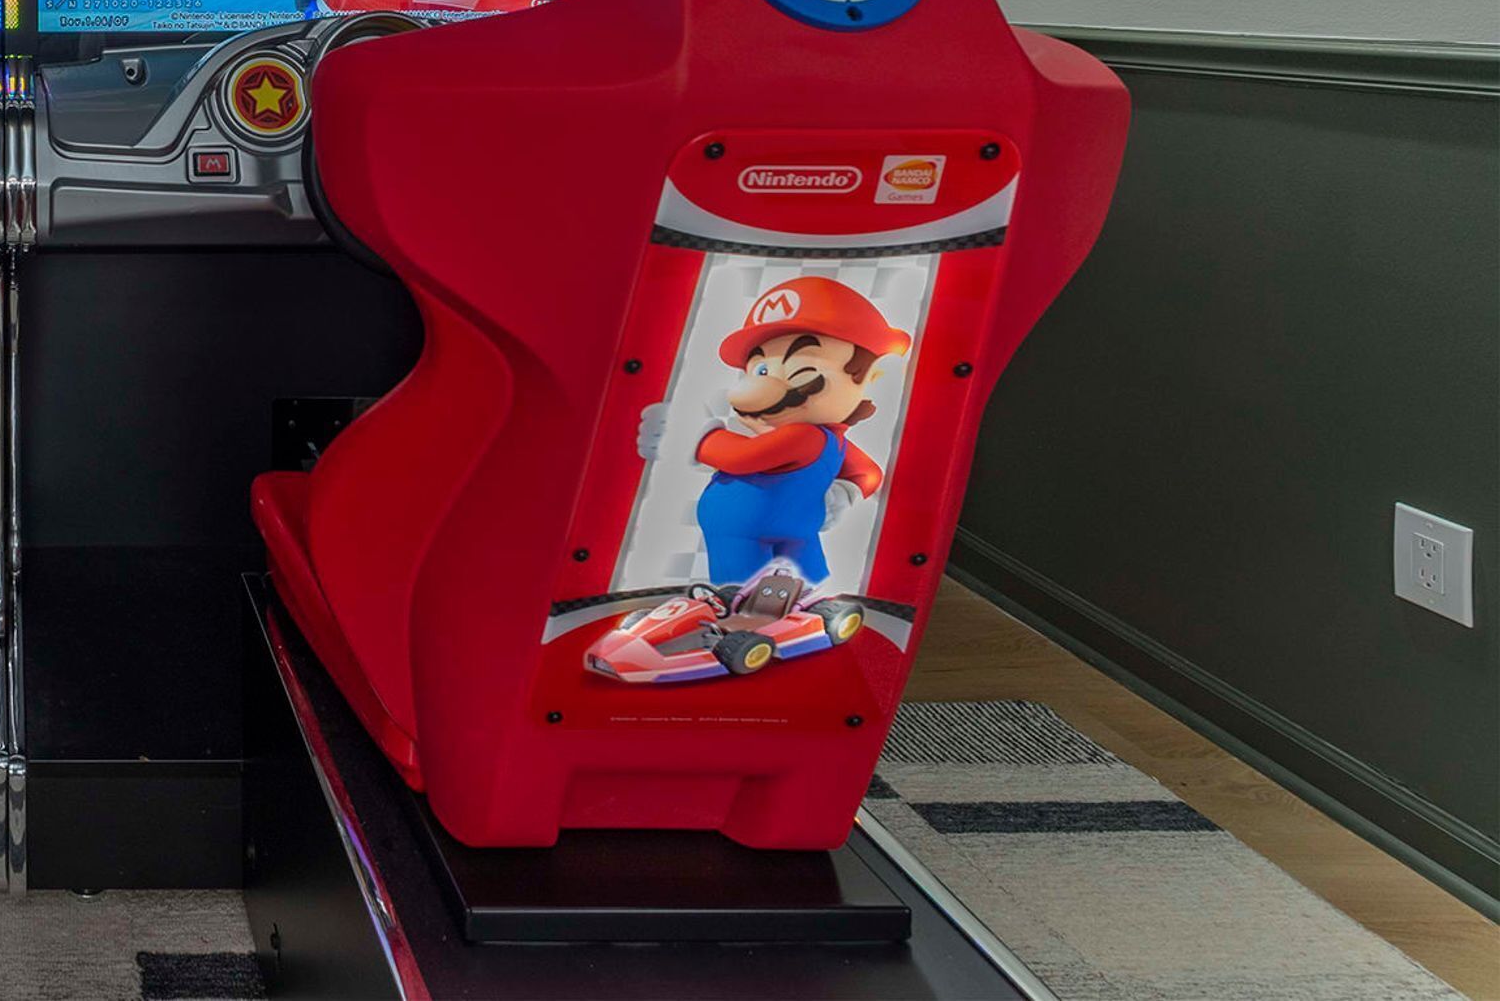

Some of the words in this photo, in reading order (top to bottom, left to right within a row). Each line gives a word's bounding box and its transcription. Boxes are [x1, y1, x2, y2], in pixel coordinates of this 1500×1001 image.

[219, 12, 255, 20] Licensed
[257, 12, 267, 22] by
[269, 12, 305, 20] Nintendo
[747, 171, 850, 187] Nintendo
[888, 192, 924, 201] Games
[758, 293, 794, 323] M
